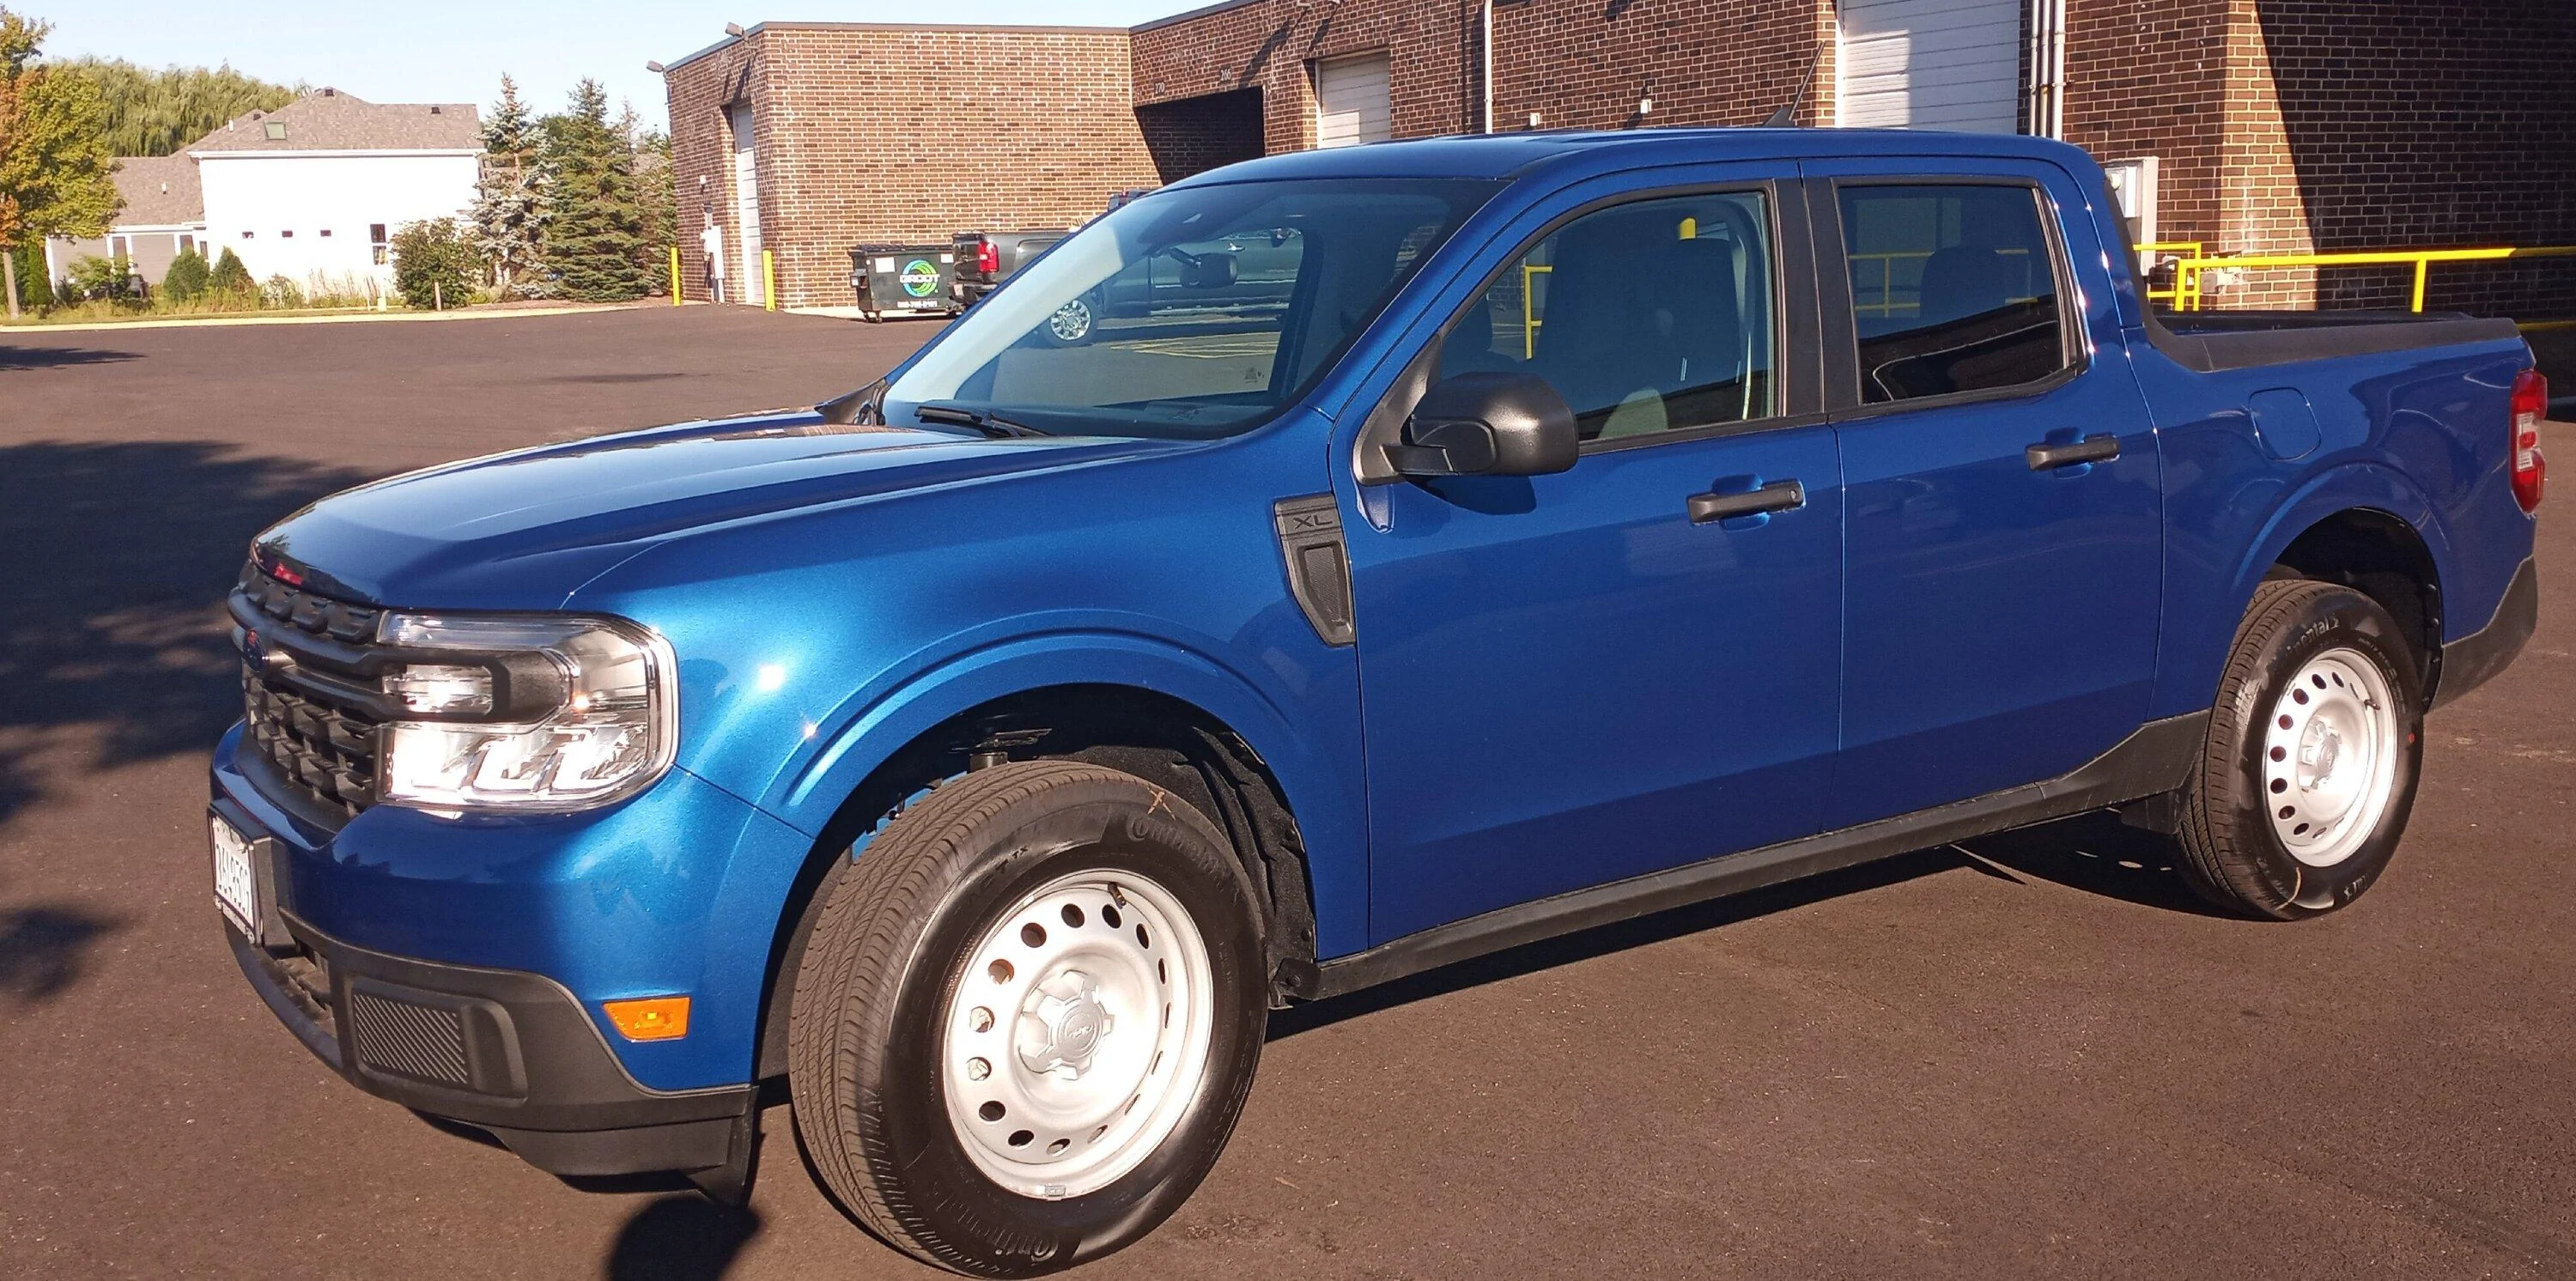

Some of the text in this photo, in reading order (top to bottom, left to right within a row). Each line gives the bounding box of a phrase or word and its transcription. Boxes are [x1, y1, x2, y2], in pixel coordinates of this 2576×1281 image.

[1155, 82, 1165, 94] 270
[900, 274, 940, 283] GROOT
[1293, 515, 1333, 530] XL
